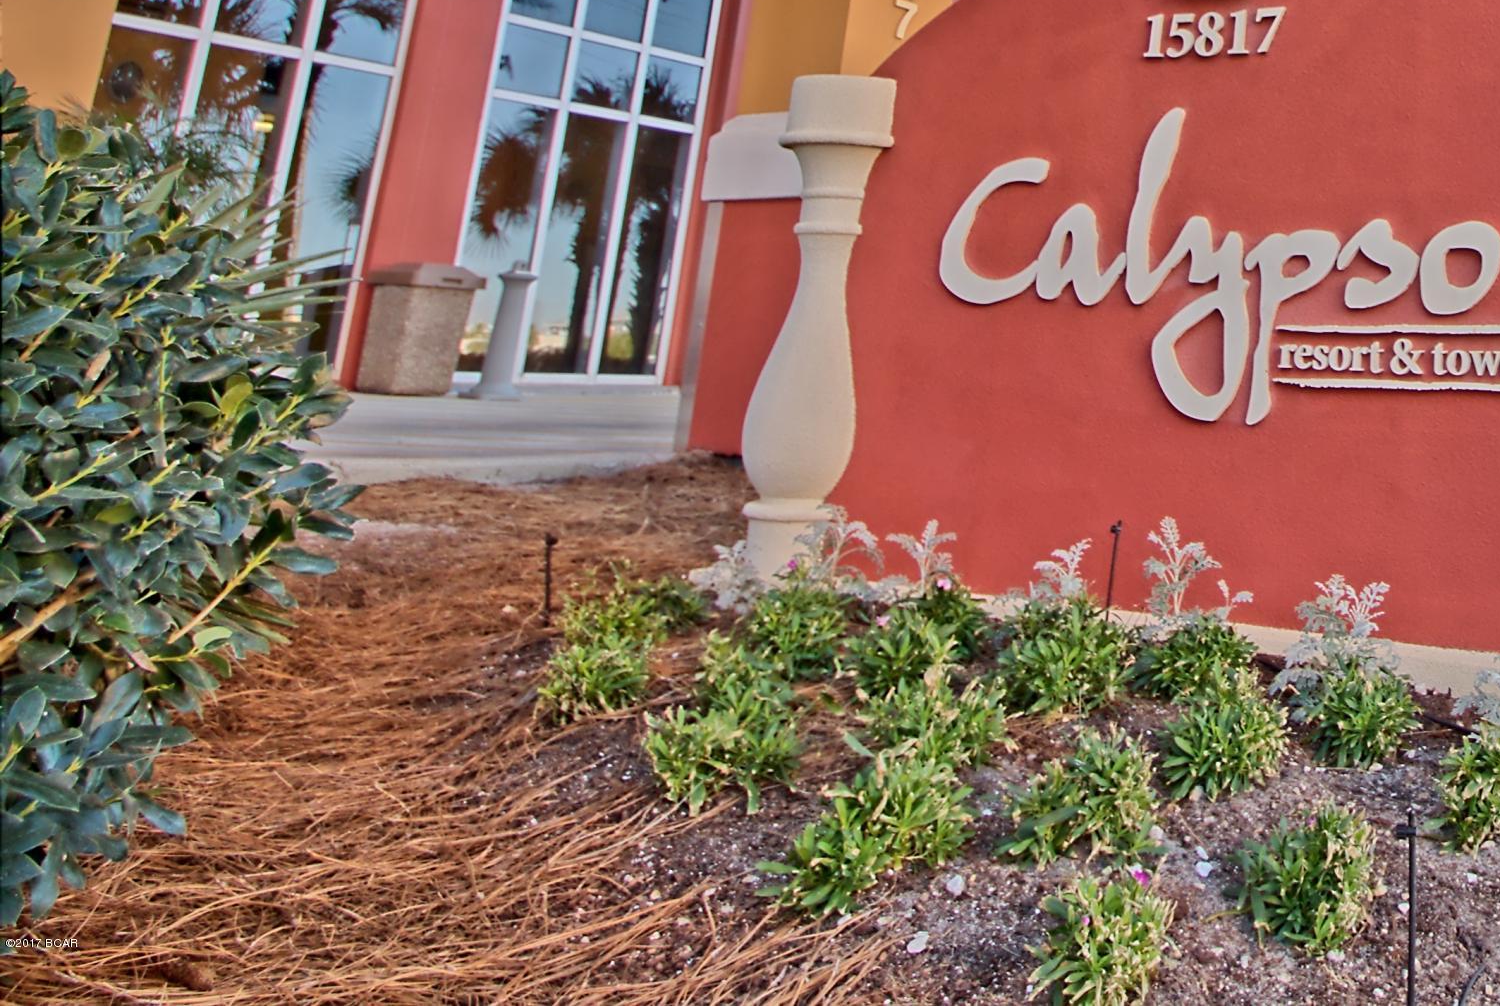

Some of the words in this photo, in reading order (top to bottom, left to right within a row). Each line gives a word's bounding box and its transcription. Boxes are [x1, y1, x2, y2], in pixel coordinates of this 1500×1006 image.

[1143, 6, 1287, 58] 15817
[1277, 341, 1384, 373] resort
[1390, 338, 1424, 375] &
